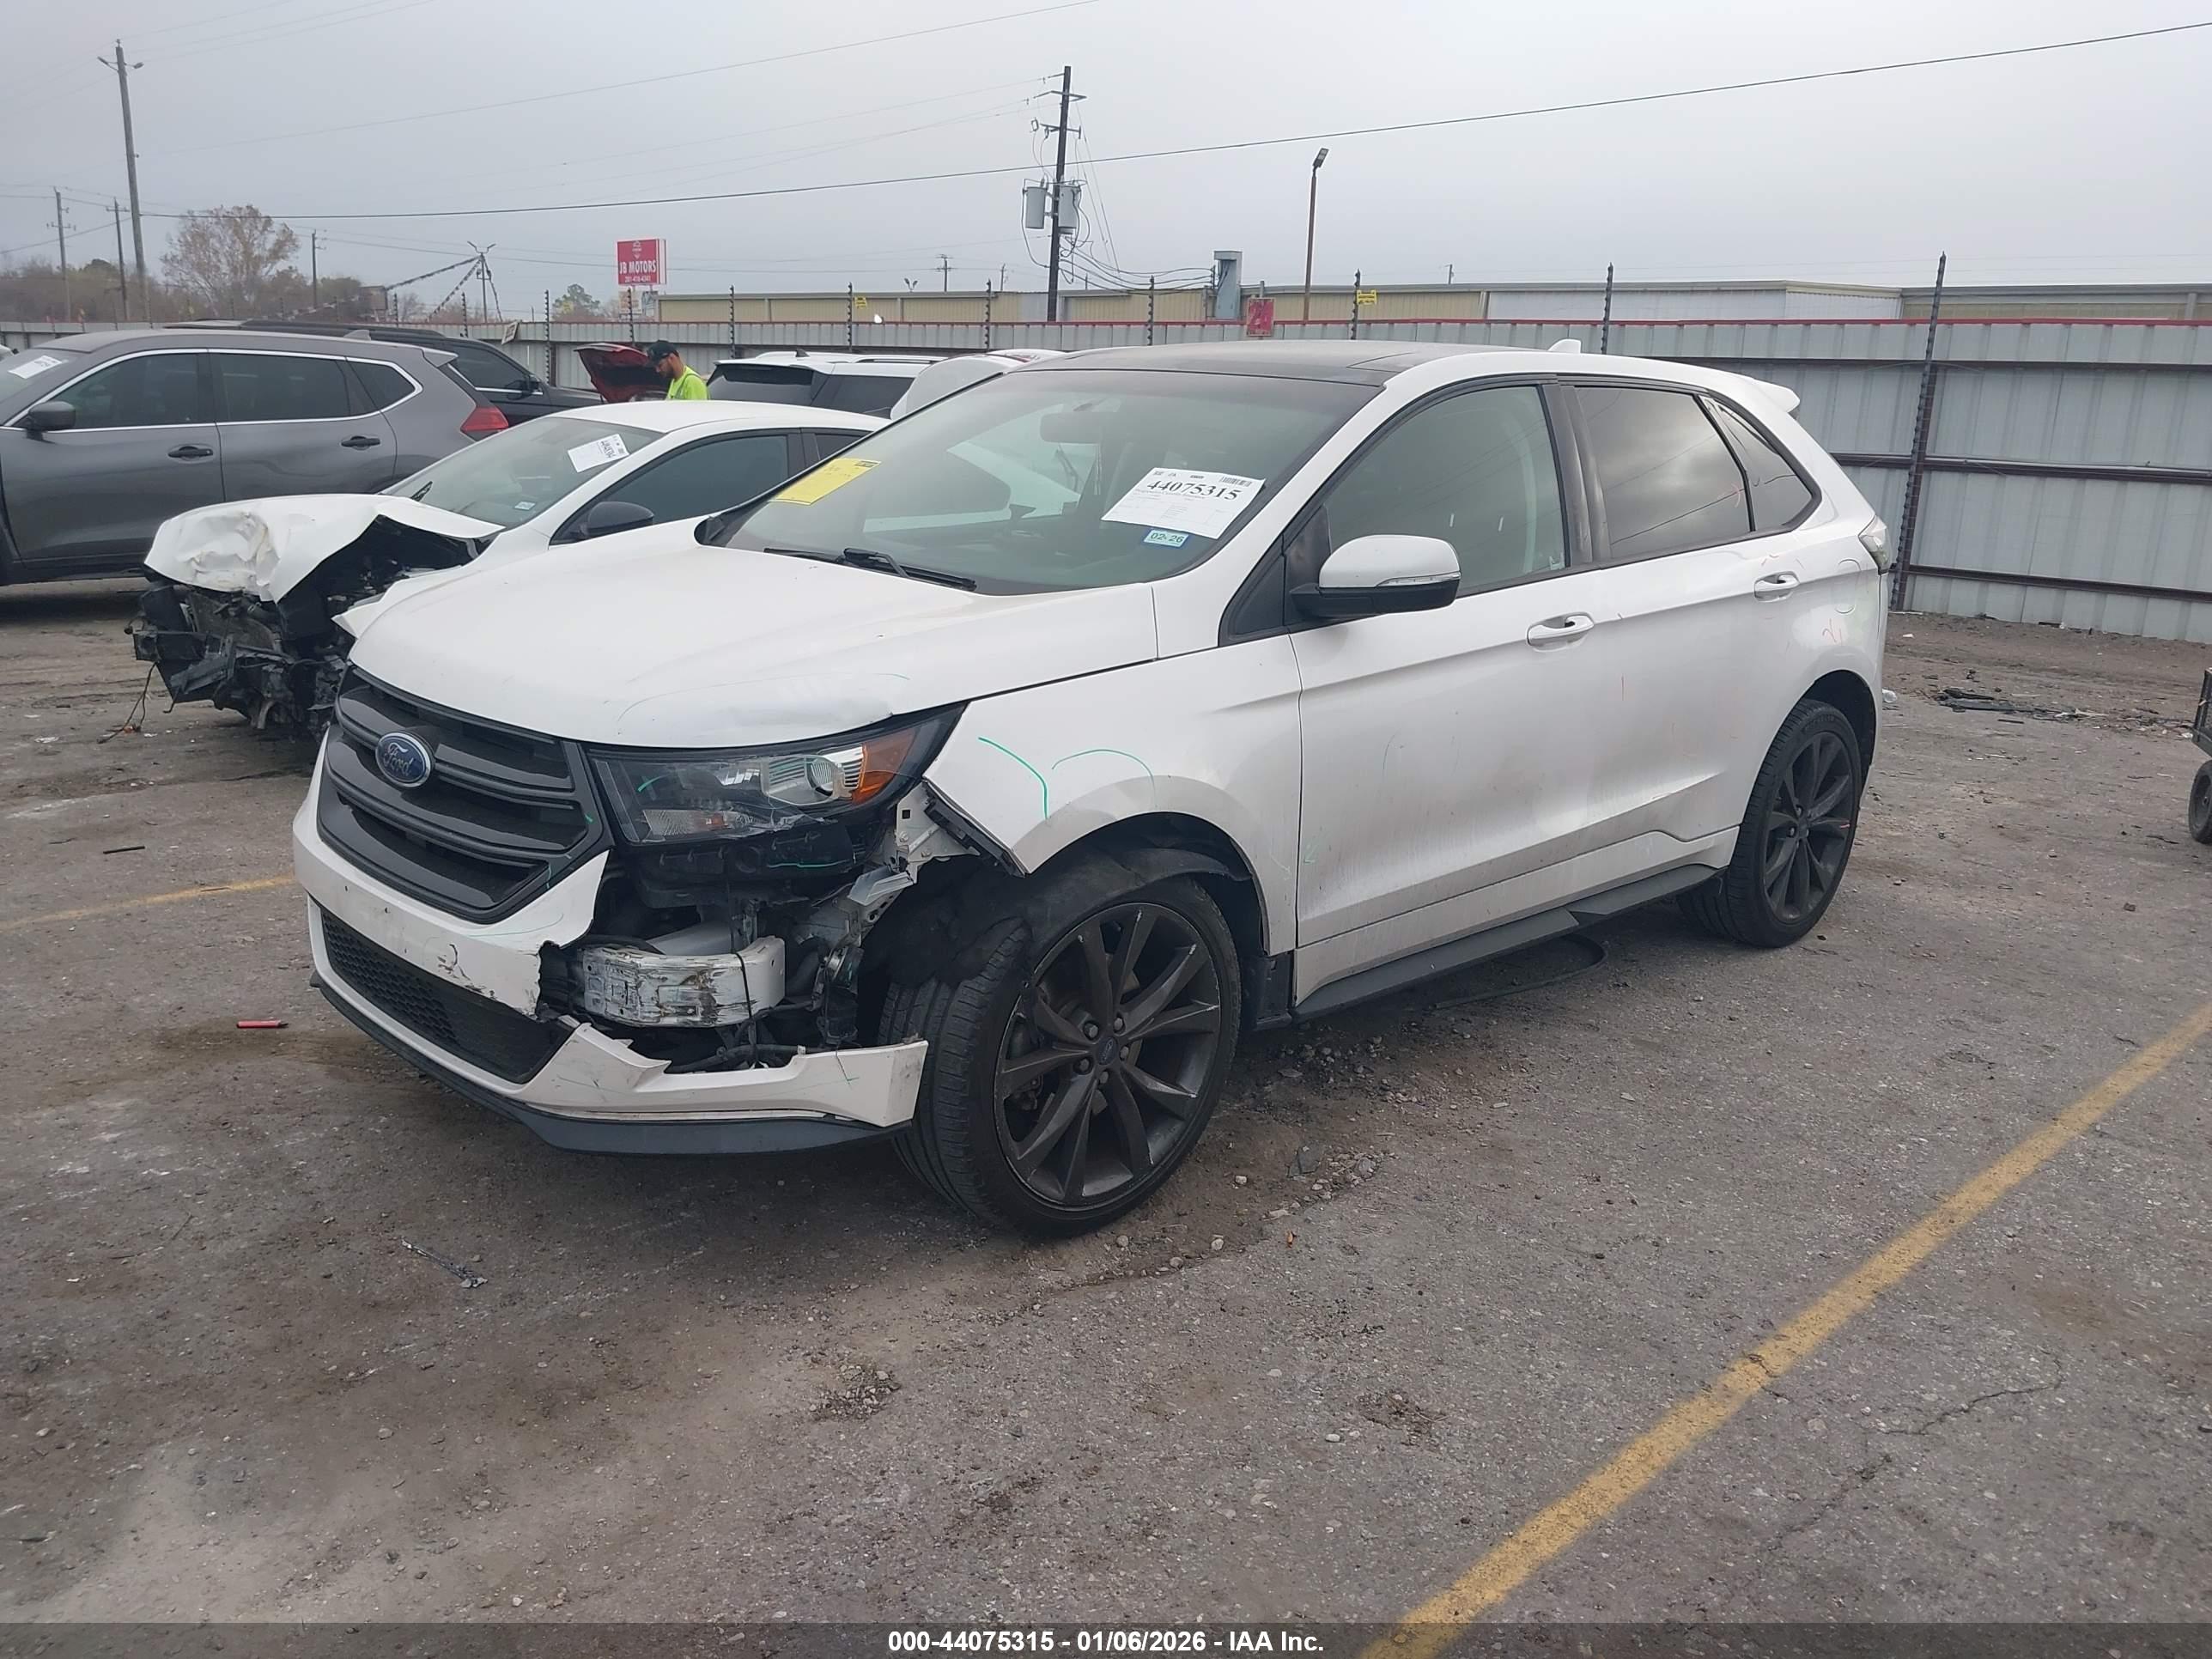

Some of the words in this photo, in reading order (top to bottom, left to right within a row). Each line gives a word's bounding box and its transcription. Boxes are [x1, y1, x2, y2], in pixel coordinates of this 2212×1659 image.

[619, 261, 628, 275] JB
[629, 260, 656, 274] MOTORS
[1147, 480, 1243, 501] 44075315
[383, 742, 415, 776] Ford
